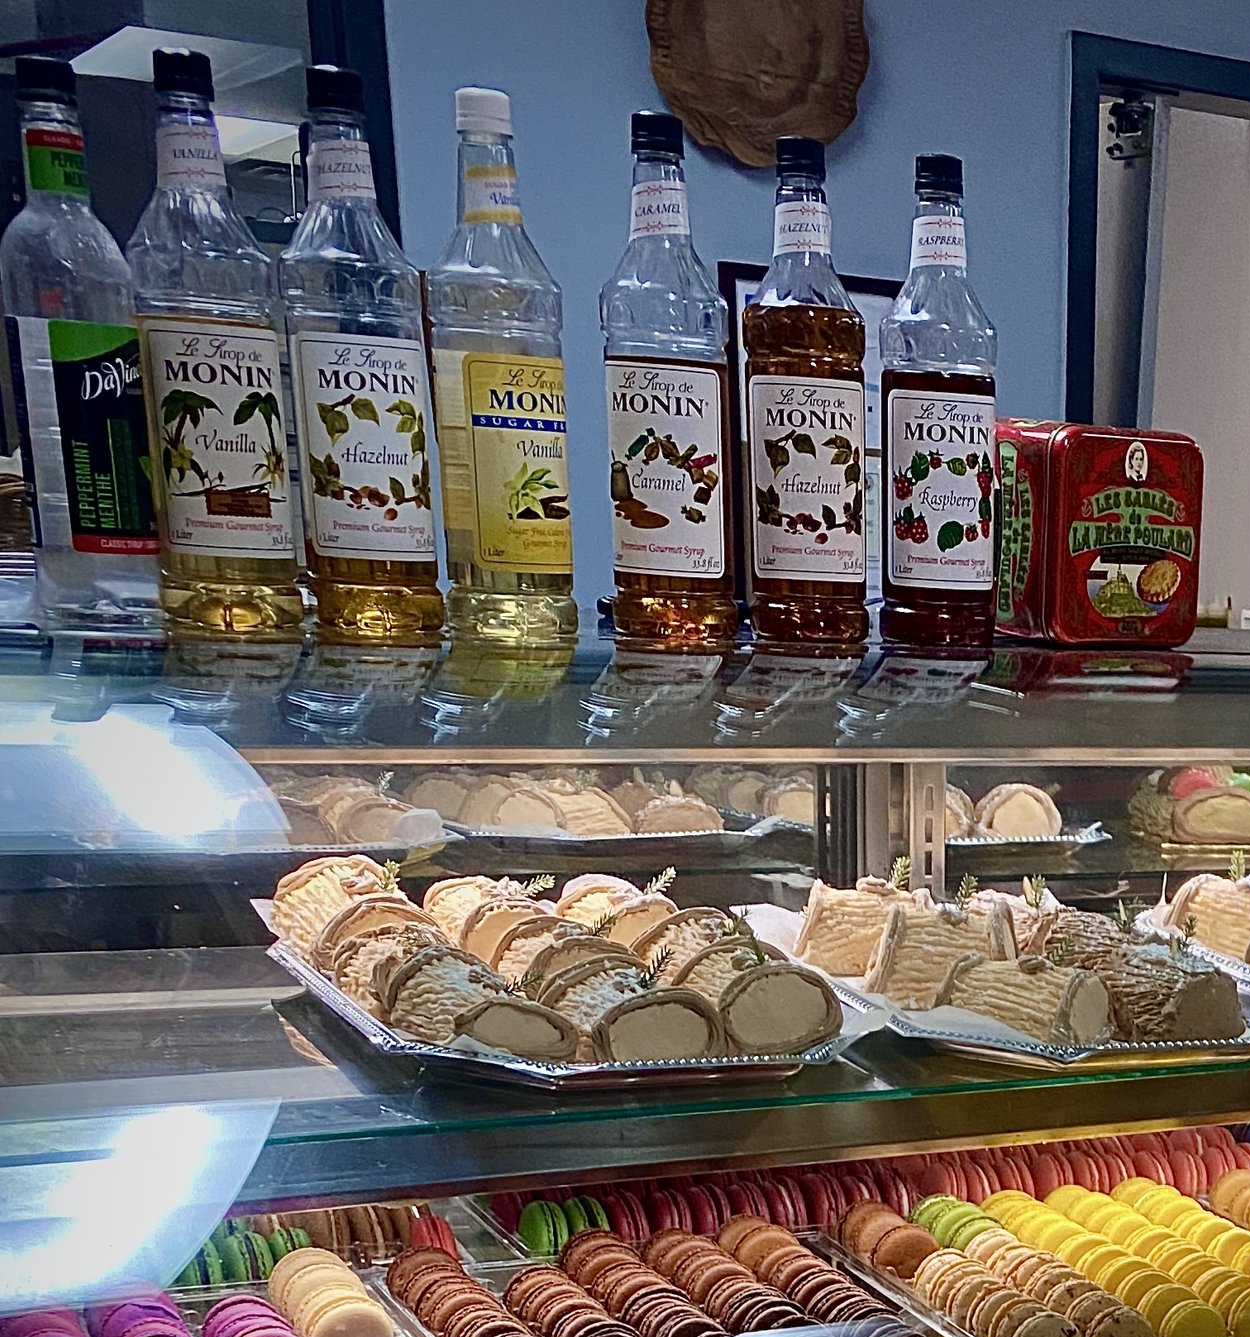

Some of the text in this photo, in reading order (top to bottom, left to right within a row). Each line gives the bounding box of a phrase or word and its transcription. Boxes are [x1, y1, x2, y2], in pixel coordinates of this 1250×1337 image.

[634, 203, 681, 218] CARAMEL
[176, 338, 262, 367] Le Sirop de
[328, 348, 407, 374] Le Sirop de
[164, 360, 272, 389] MONIN
[318, 369, 416, 396] MONIN
[502, 369, 524, 386] Le
[618, 371, 694, 396] Le Sirop de
[612, 392, 704, 418] MONIN
[775, 388, 845, 412] Le Sirop de
[480, 416, 545, 429] SUGAR
[766, 408, 853, 432] MONIN
[914, 403, 984, 425] Le Sirop de
[195, 429, 256, 454] Vanilla
[904, 422, 989, 446] MONIN
[342, 441, 408, 466] Hazelnut
[517, 437, 563, 459] Vanilla
[72, 440, 97, 528] PEPPERMINT
[632, 468, 686, 492] Caramel
[781, 473, 841, 495] Hazelnut
[95, 473, 116, 528] MENTHE
[919, 486, 978, 512] Raspberry
[1094, 491, 1121, 514] LES
[1129, 509, 1141, 525] de
[648, 543, 683, 554] Gourmet
[1072, 526, 1091, 554] LA
[1134, 526, 1192, 556] POULARD
